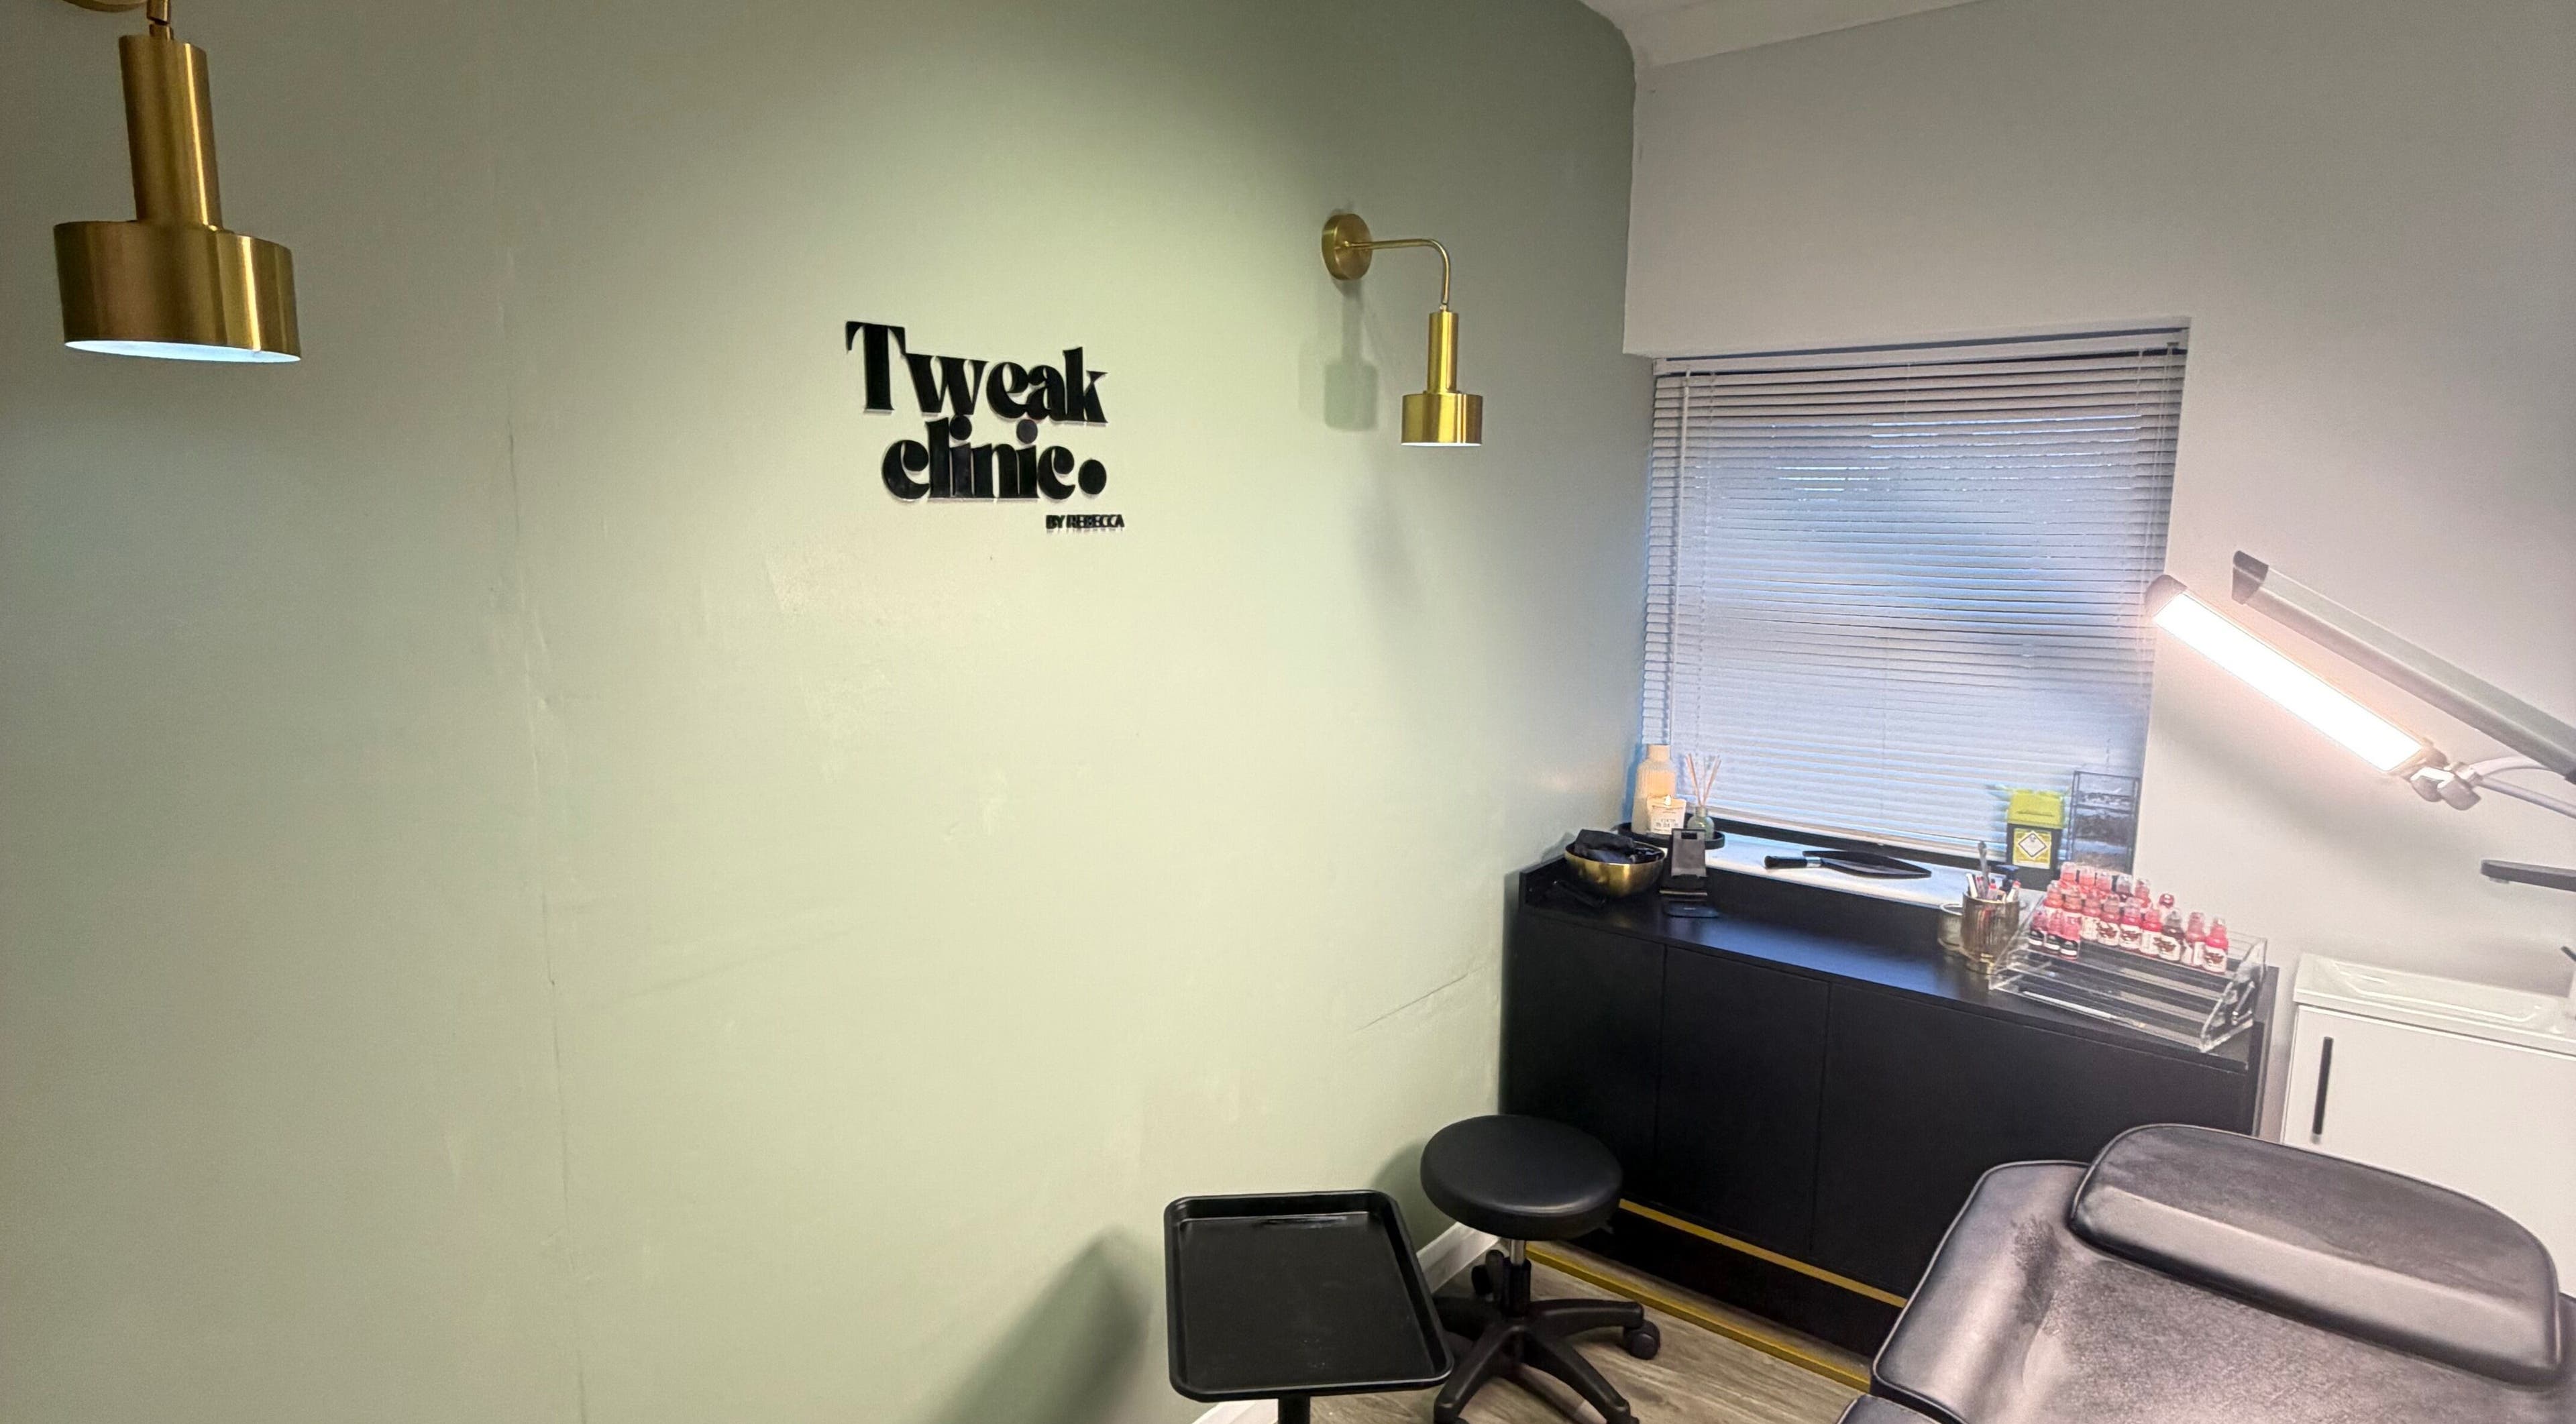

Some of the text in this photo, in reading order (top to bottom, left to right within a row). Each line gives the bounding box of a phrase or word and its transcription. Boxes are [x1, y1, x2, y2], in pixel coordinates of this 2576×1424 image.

[845, 321, 1108, 424] Tweak
[1045, 513, 1125, 529] BY REBECCA
